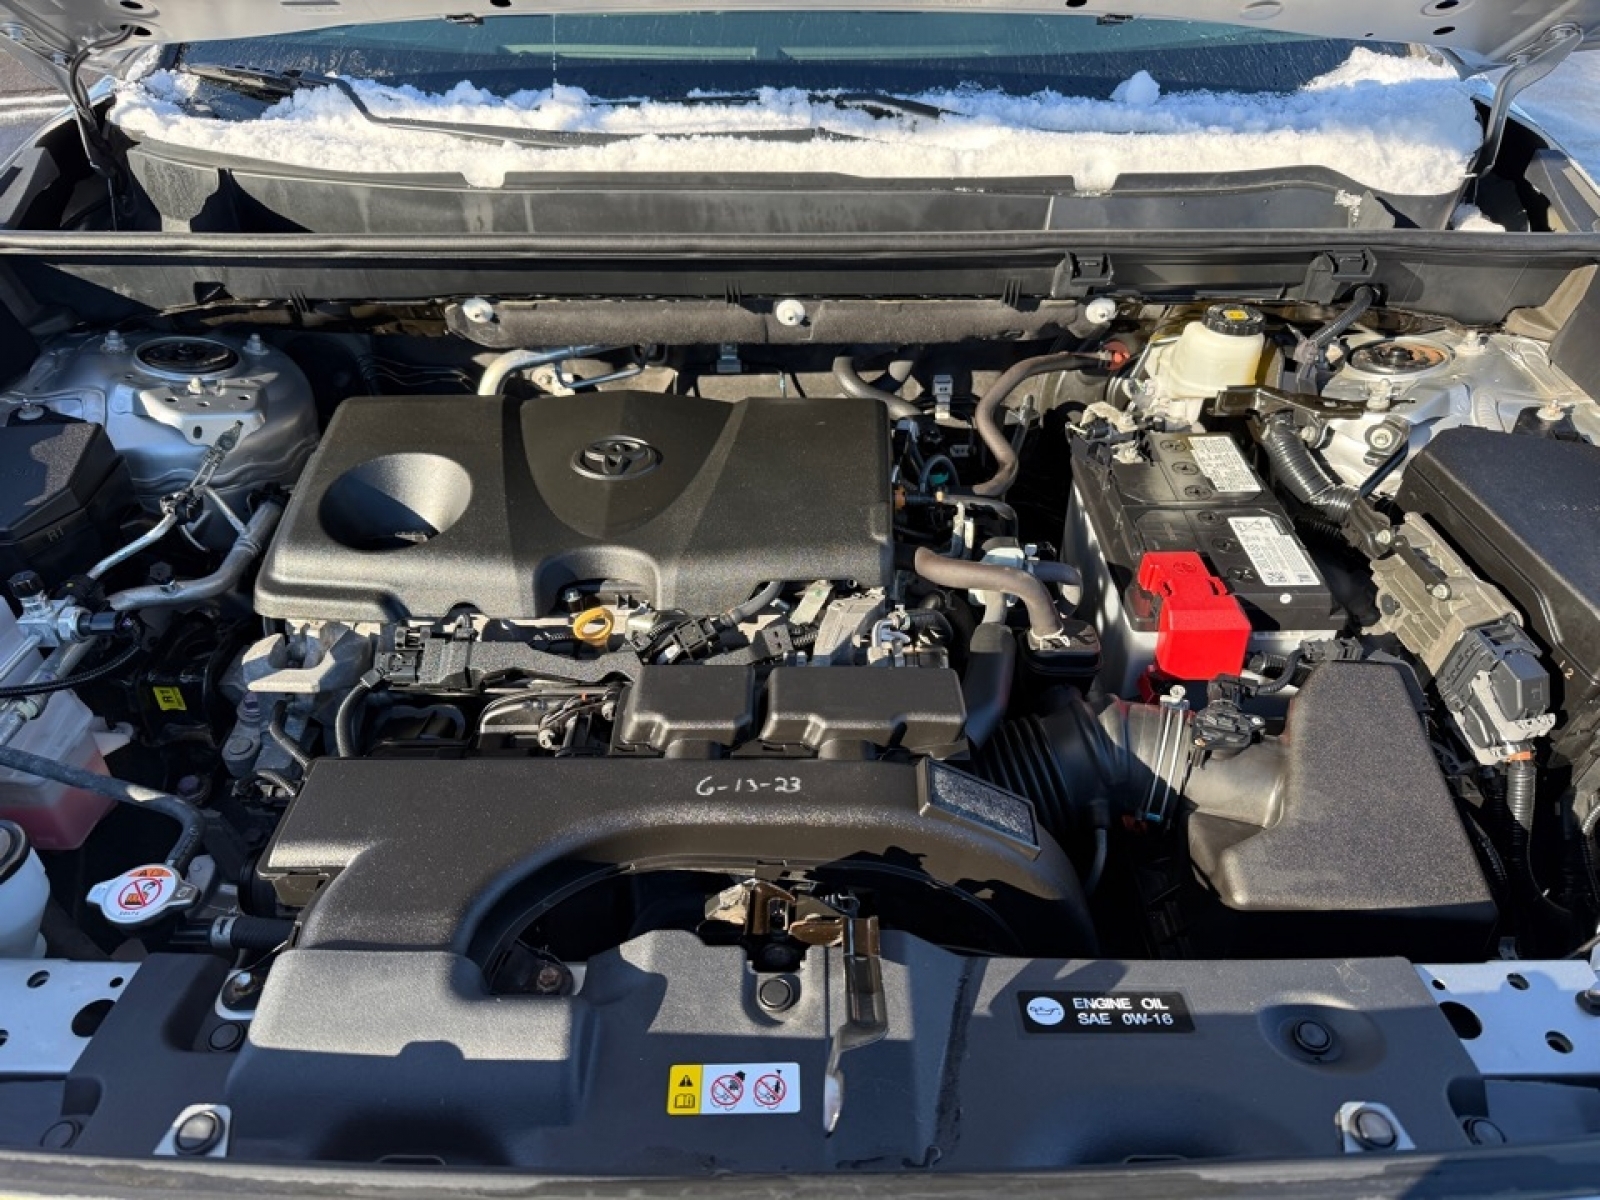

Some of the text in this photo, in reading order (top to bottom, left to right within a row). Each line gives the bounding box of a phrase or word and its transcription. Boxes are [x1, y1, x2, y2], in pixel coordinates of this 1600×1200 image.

[696, 775, 801, 796] 6-13-23
[1073, 997, 1169, 1010] ENGINE OIL
[1077, 1012, 1174, 1026] SAE 0W-16
